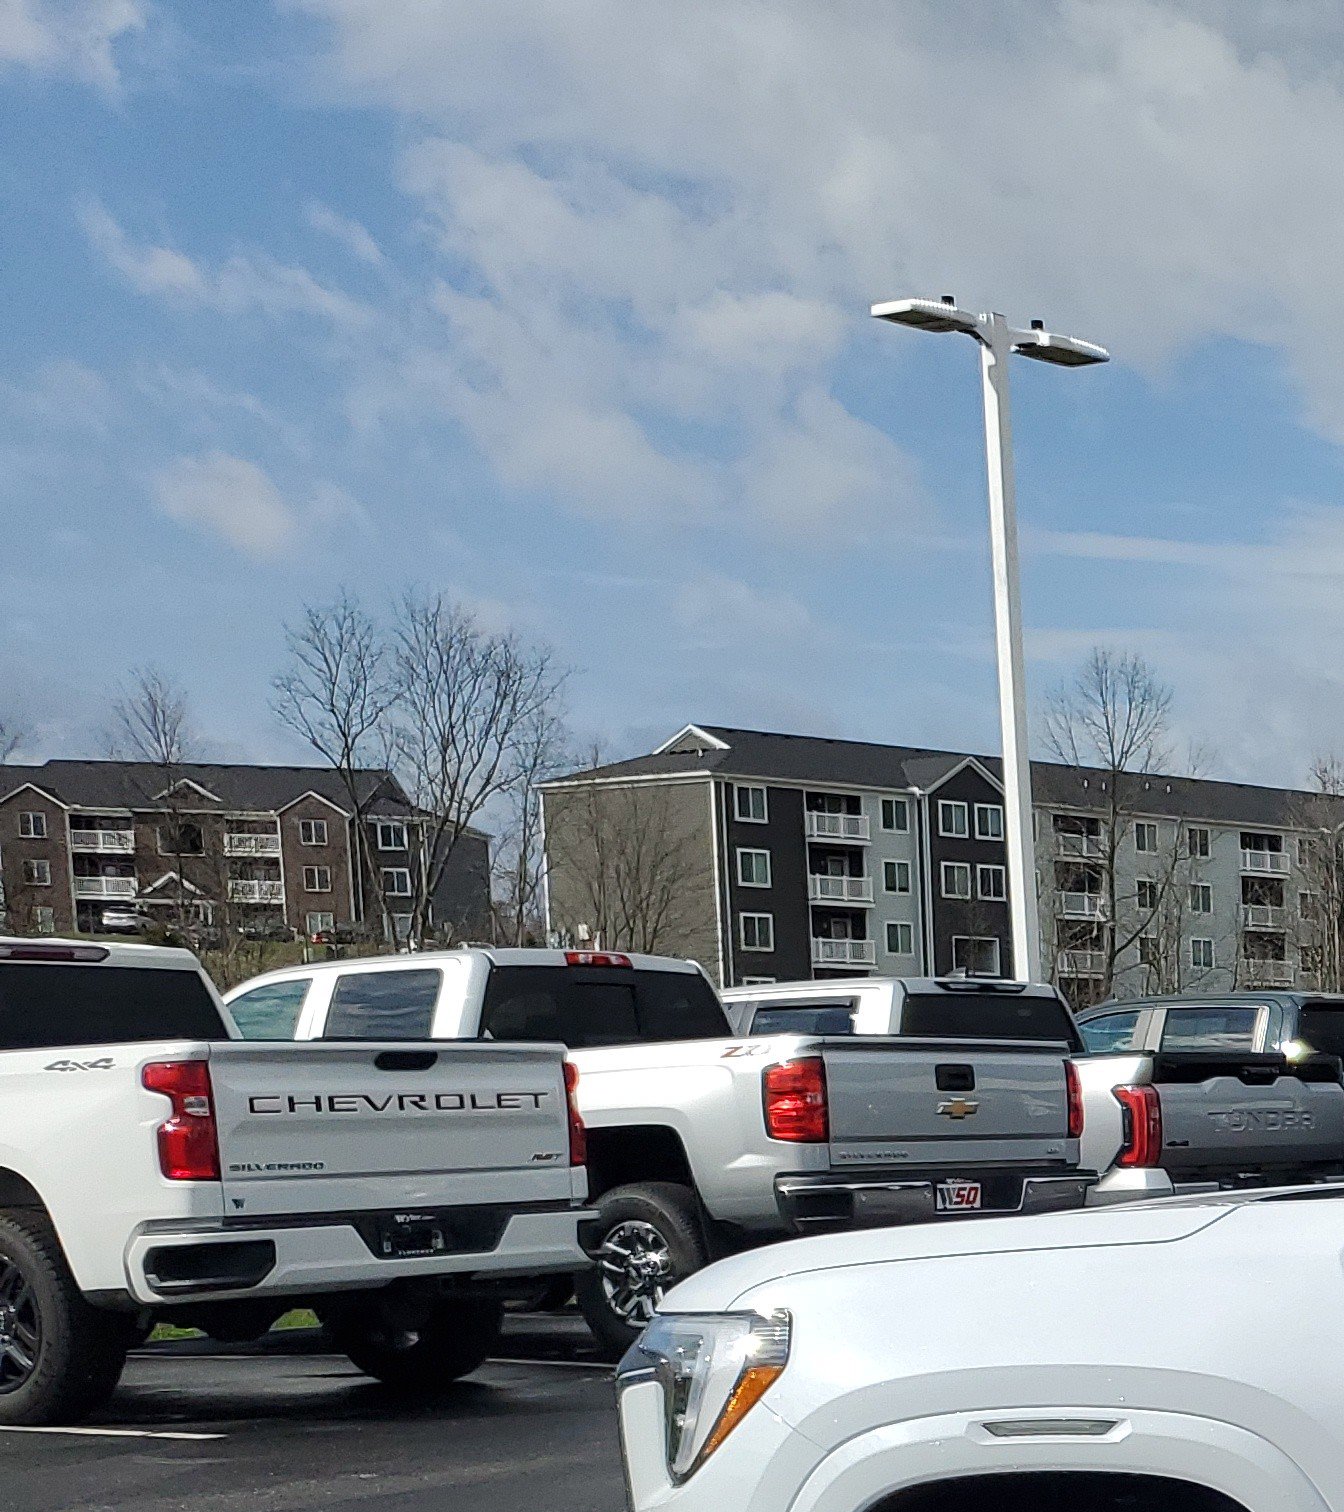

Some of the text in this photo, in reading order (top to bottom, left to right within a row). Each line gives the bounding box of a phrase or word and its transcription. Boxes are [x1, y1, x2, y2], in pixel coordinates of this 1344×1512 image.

[249, 1092, 549, 1114] CHEVROLET
[1207, 1110, 1316, 1132] TUNDRA
[229, 1162, 325, 1172] SILVERADO
